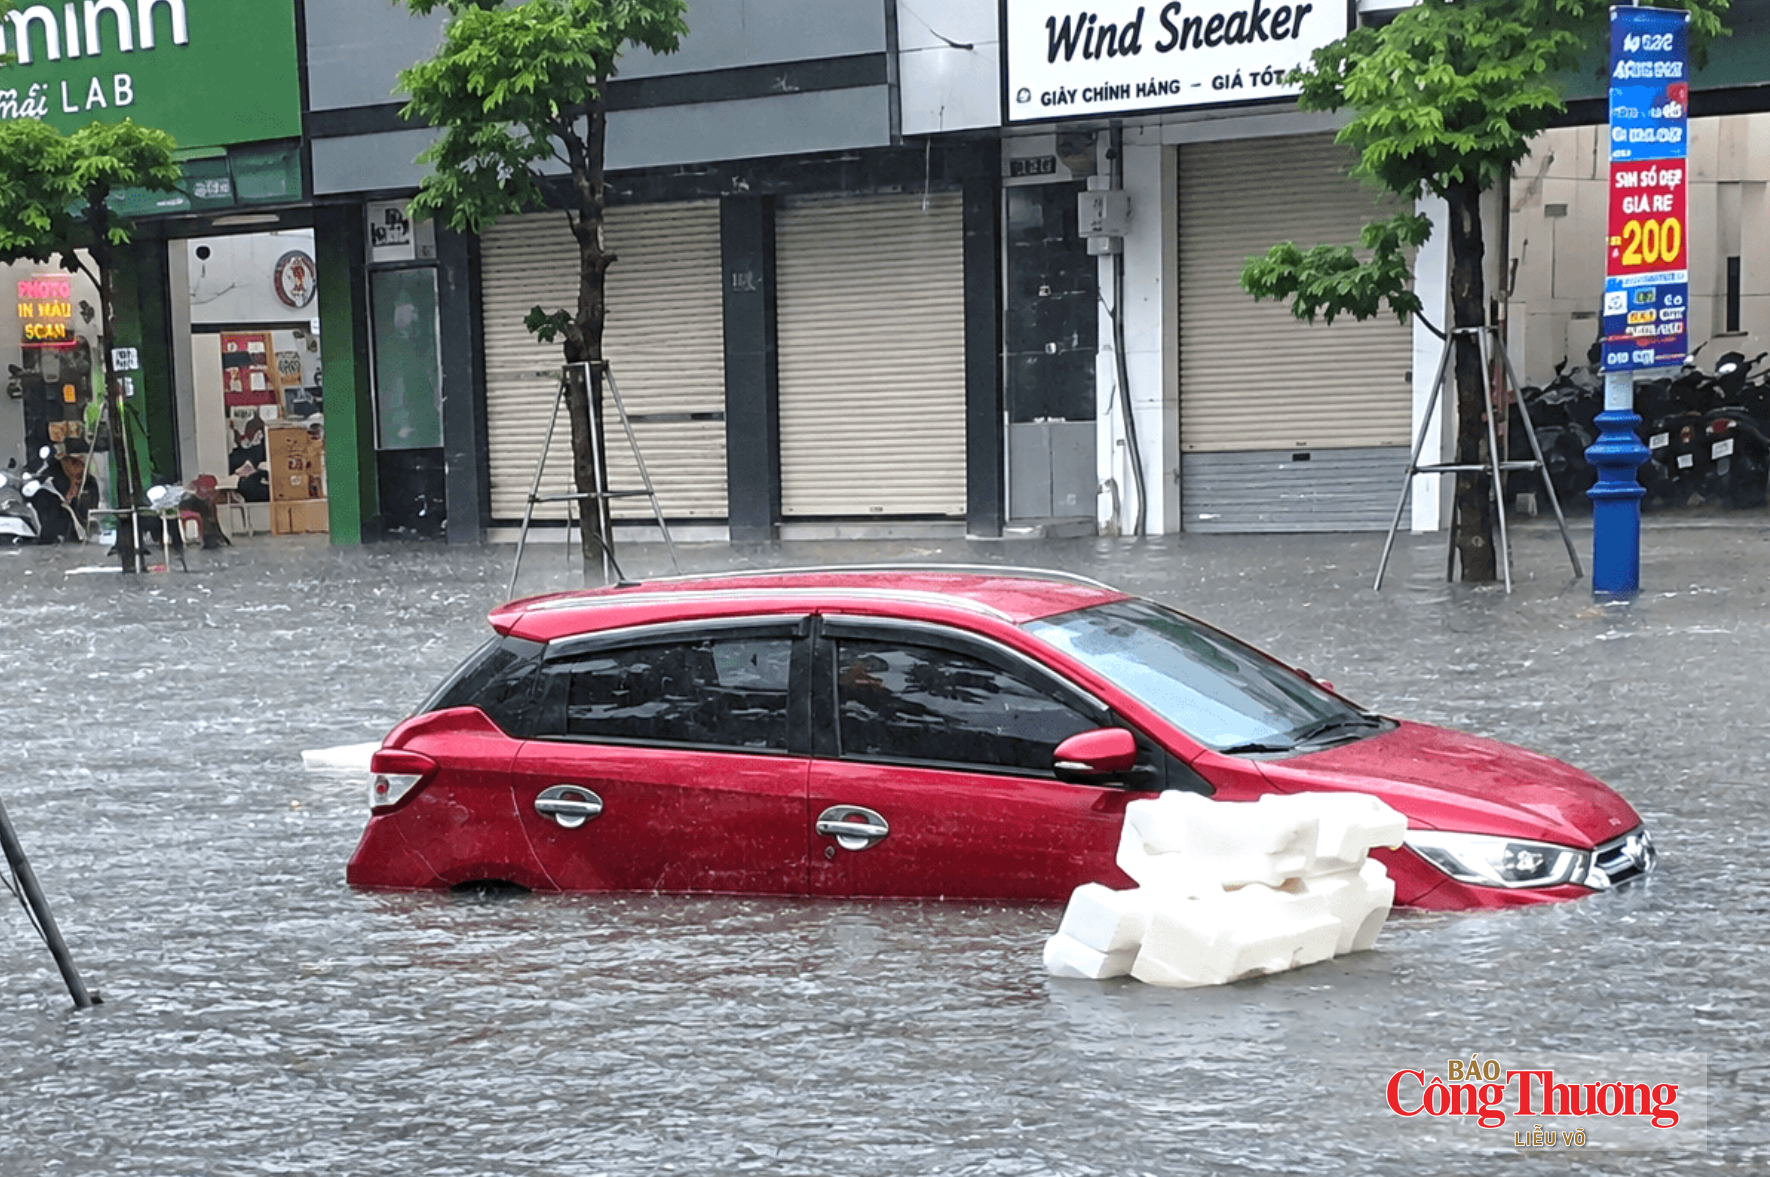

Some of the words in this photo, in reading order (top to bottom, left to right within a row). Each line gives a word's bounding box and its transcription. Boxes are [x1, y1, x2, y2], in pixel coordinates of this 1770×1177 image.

[1045, 6, 1145, 64] Wind
[1155, 0, 1313, 54] Sneaker
[61, 73, 134, 113] LAB
[1622, 217, 1681, 266] 200
[18, 281, 71, 298] PHOTO
[18, 303, 33, 317] IN
[25, 323, 66, 339] SCAN
